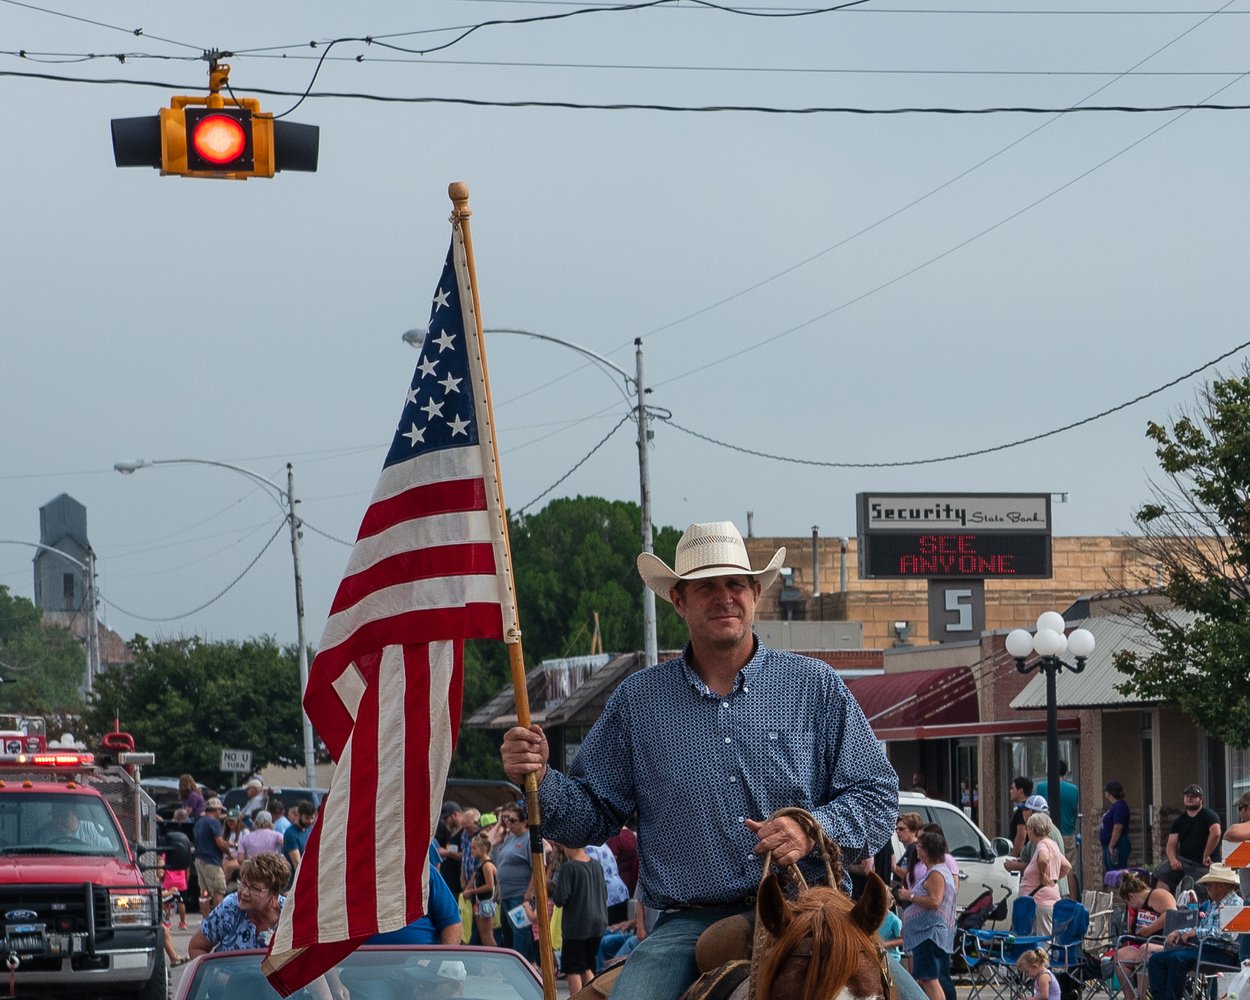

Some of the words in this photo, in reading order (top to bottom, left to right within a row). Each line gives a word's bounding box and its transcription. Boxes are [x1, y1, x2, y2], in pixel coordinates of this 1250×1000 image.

[871, 503, 967, 526] Security
[970, 512, 1004, 522] State
[1006, 512, 1044, 522] Bank
[919, 535, 976, 553] SEE
[899, 555, 1016, 573] ANYONE
[224, 751, 237, 761] NO
[242, 752, 249, 761] U
[227, 761, 245, 769] TURN
